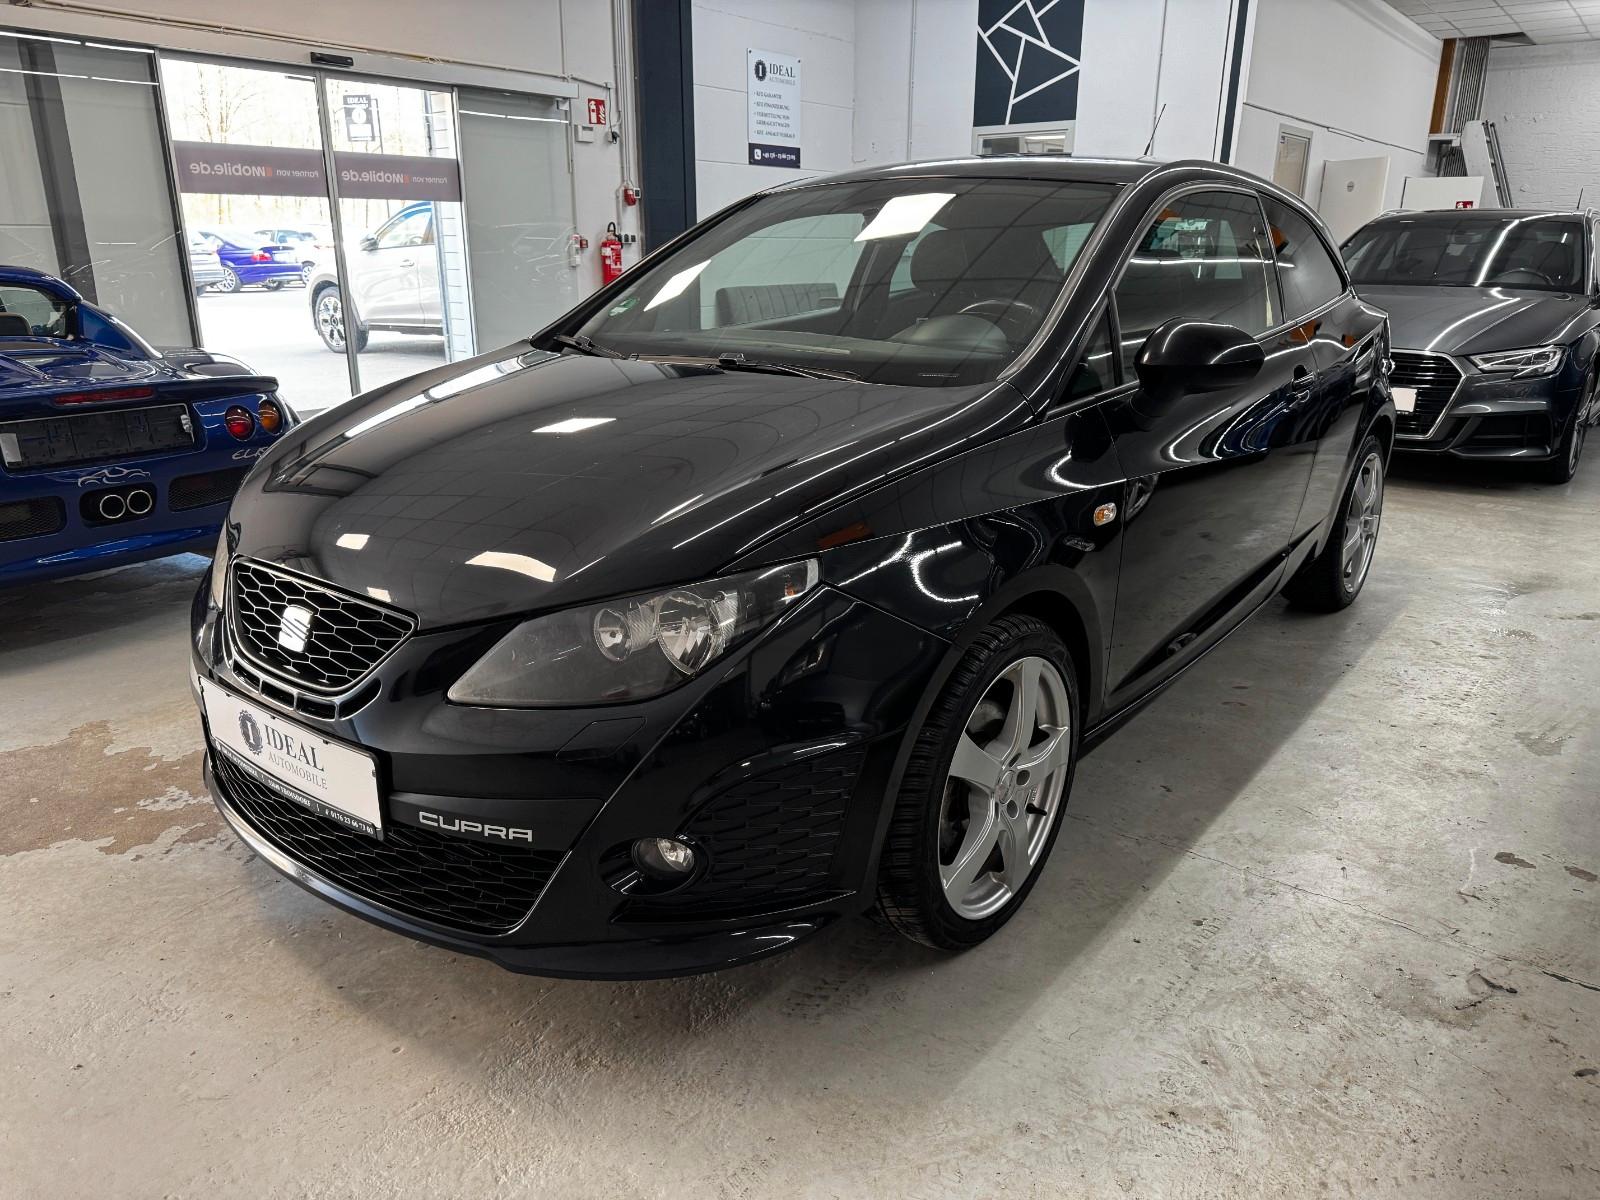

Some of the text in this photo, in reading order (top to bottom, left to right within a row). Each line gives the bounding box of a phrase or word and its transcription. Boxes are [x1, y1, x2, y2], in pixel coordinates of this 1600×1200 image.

[769, 63, 796, 78] IDEAL
[264, 724, 325, 773] IDEAL
[268, 751, 328, 790] AUTOMOBILE
[419, 811, 533, 842] CUPRA
